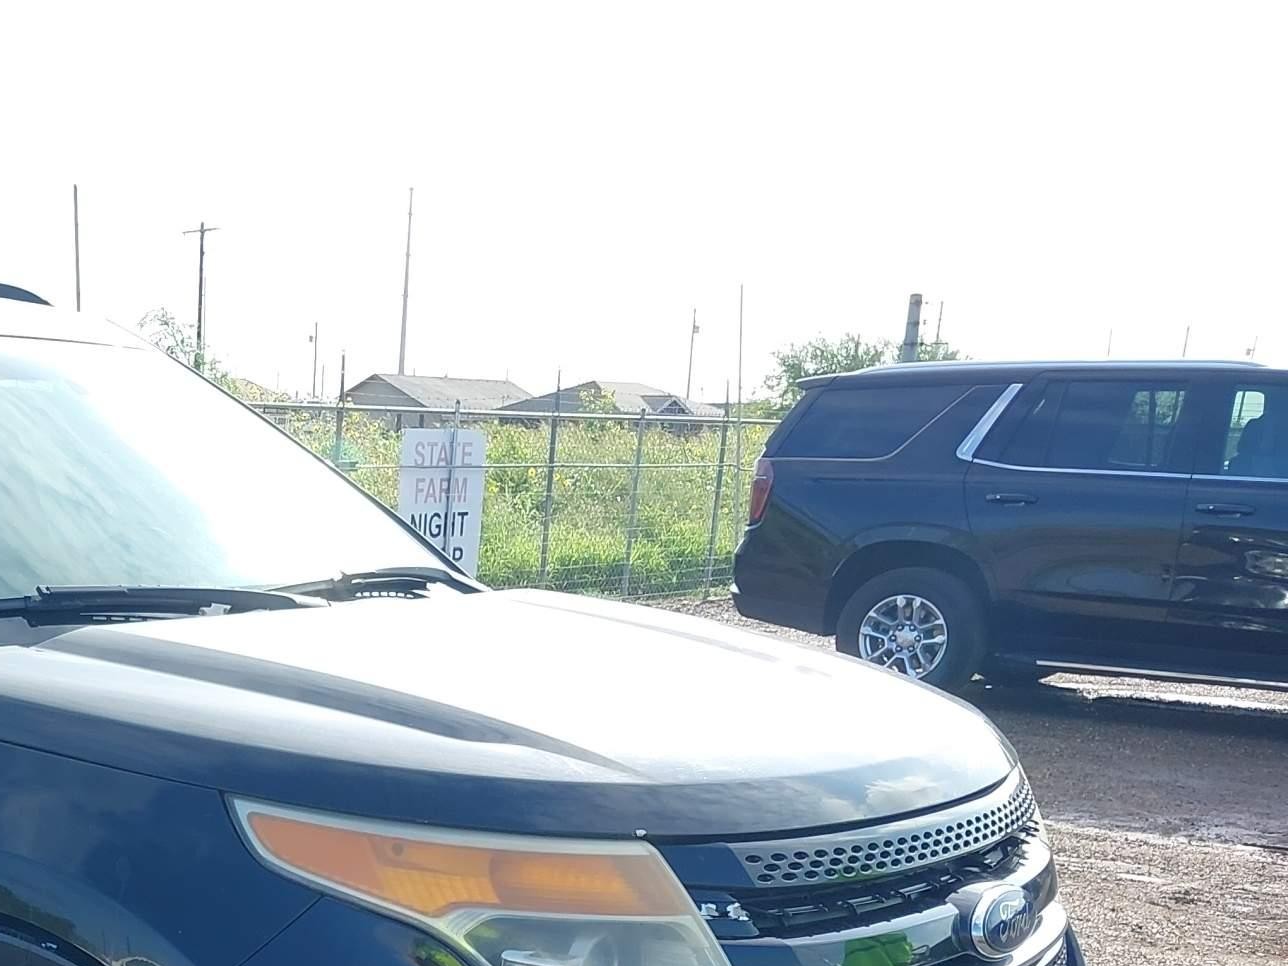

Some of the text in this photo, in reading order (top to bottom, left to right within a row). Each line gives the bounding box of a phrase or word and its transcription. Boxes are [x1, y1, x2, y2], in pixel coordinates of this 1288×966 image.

[414, 477, 468, 504] FARM
[410, 511, 469, 539] NIGHT
[998, 898, 1031, 943] Ford
